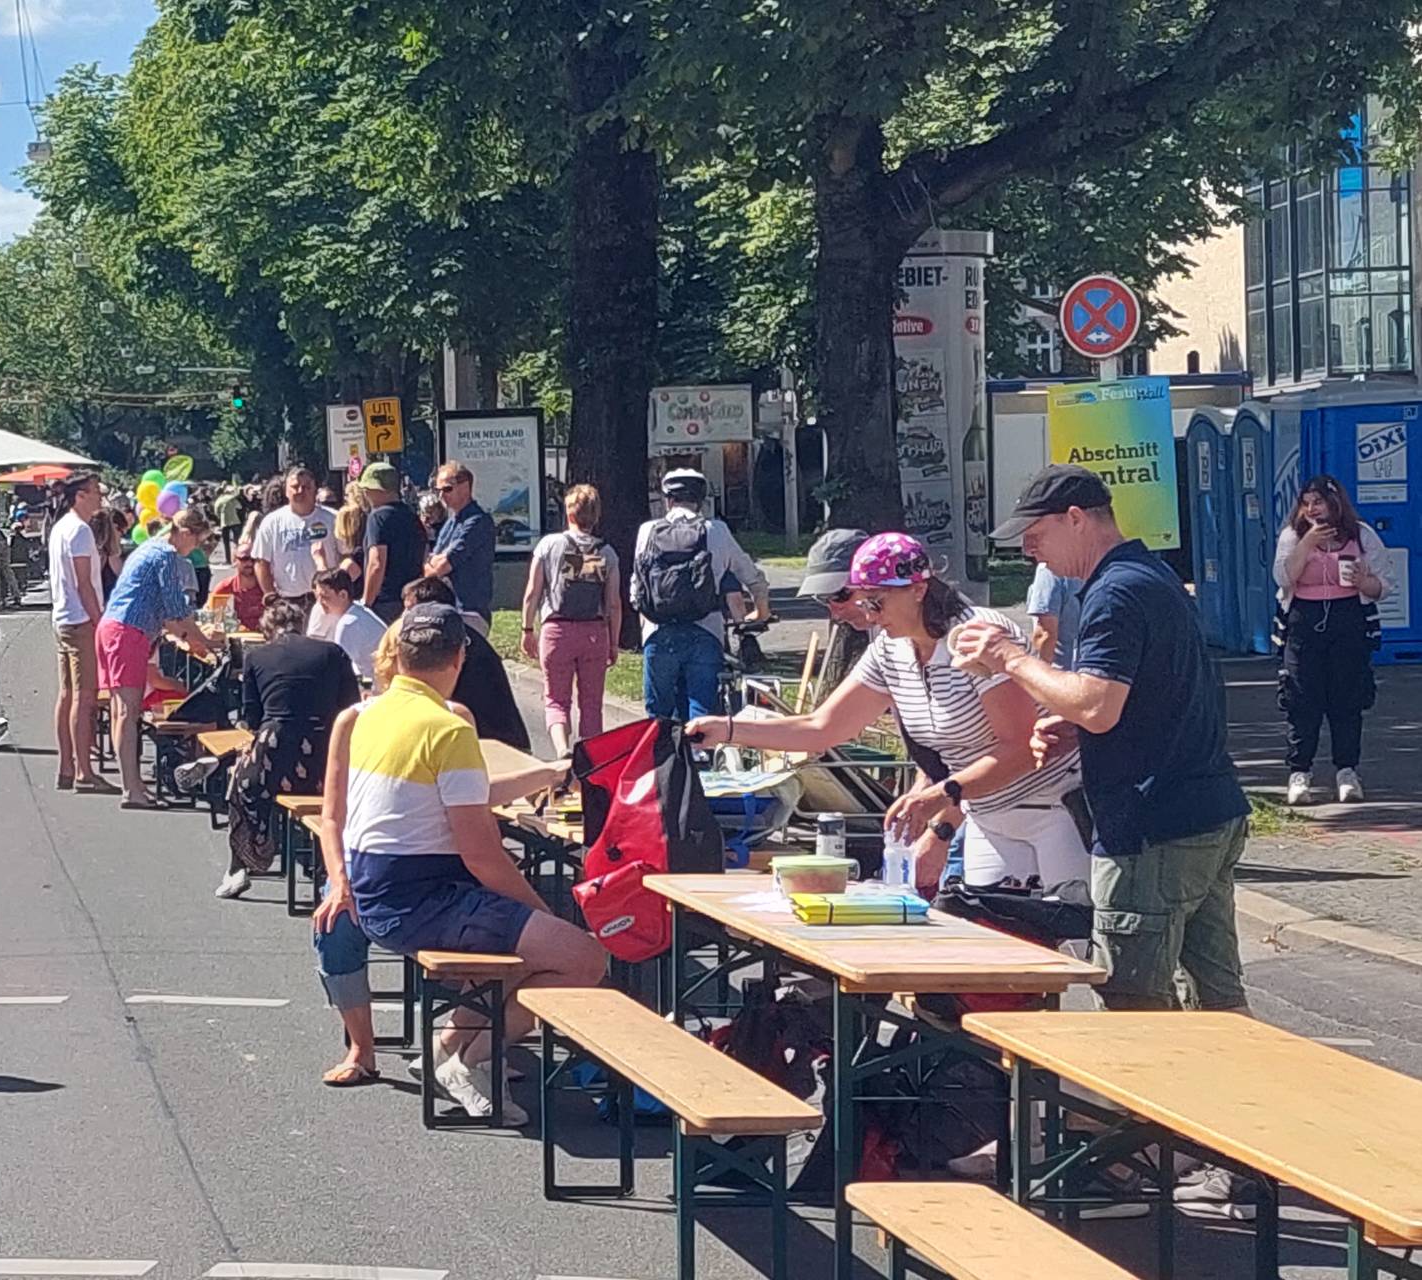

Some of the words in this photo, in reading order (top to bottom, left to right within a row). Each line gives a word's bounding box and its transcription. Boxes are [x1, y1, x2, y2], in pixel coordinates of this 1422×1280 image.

[458, 430, 481, 440] MEIN
[482, 429, 524, 439] NEULAND
[1068, 441, 1160, 464] Abschnitt
[1098, 461, 1161, 486] ntral
